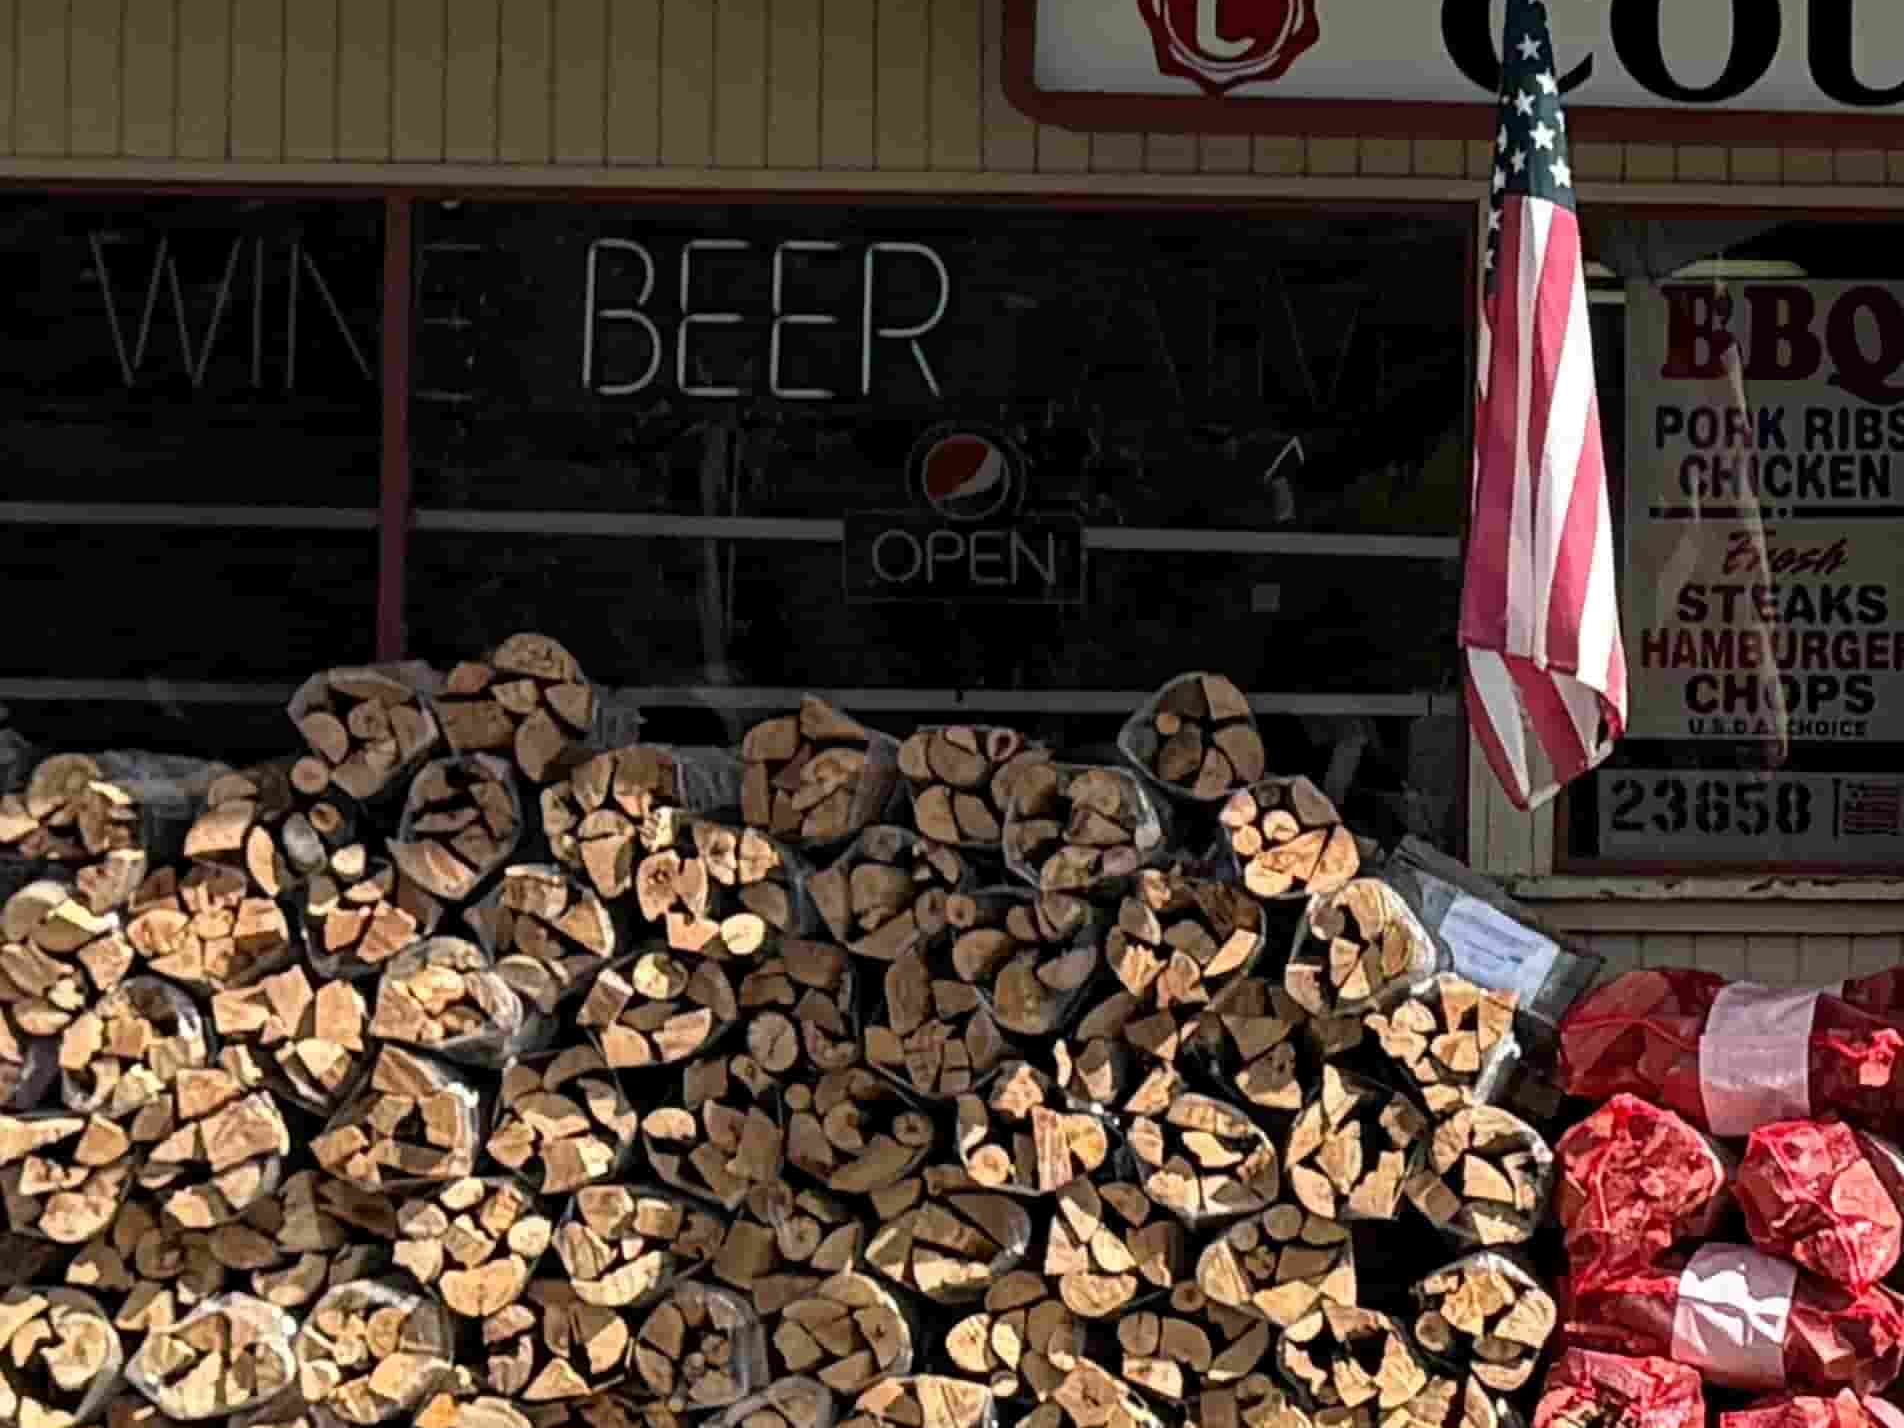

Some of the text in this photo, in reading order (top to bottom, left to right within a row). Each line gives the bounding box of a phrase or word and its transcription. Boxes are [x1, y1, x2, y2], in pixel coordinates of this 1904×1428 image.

[582, 237, 950, 398] BEER
[1655, 406, 1786, 449] PORK
[1678, 454, 1891, 498] CHICKEN
[871, 527, 1057, 586] OPEN
[1676, 583, 1888, 624] STEAKS
[1685, 673, 1876, 714] CHOPS
